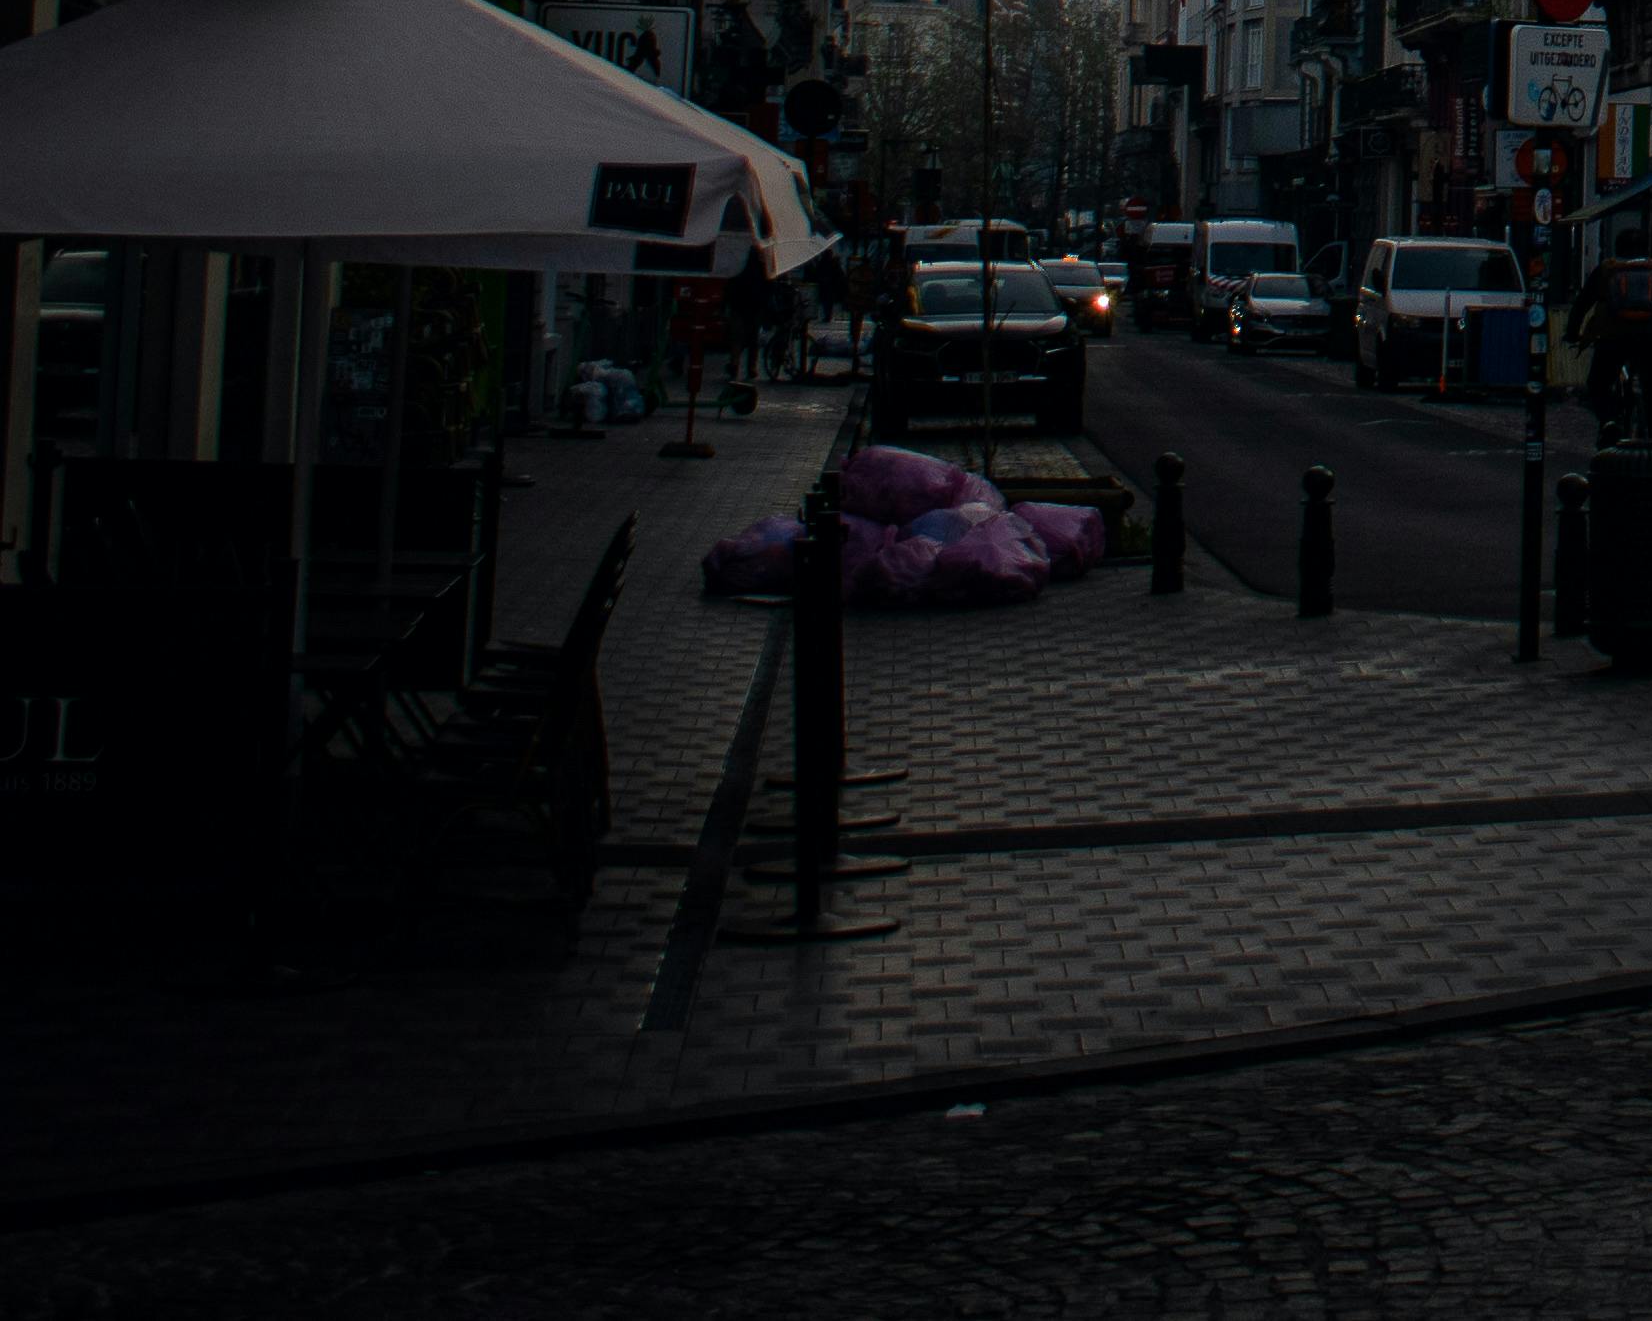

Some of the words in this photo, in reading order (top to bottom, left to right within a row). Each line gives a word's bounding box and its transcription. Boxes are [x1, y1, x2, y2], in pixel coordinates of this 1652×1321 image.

[1529, 51, 1597, 68] UITGEZONDERD
[606, 180, 679, 204] PAUL
[41, 768, 98, 792] 1889
